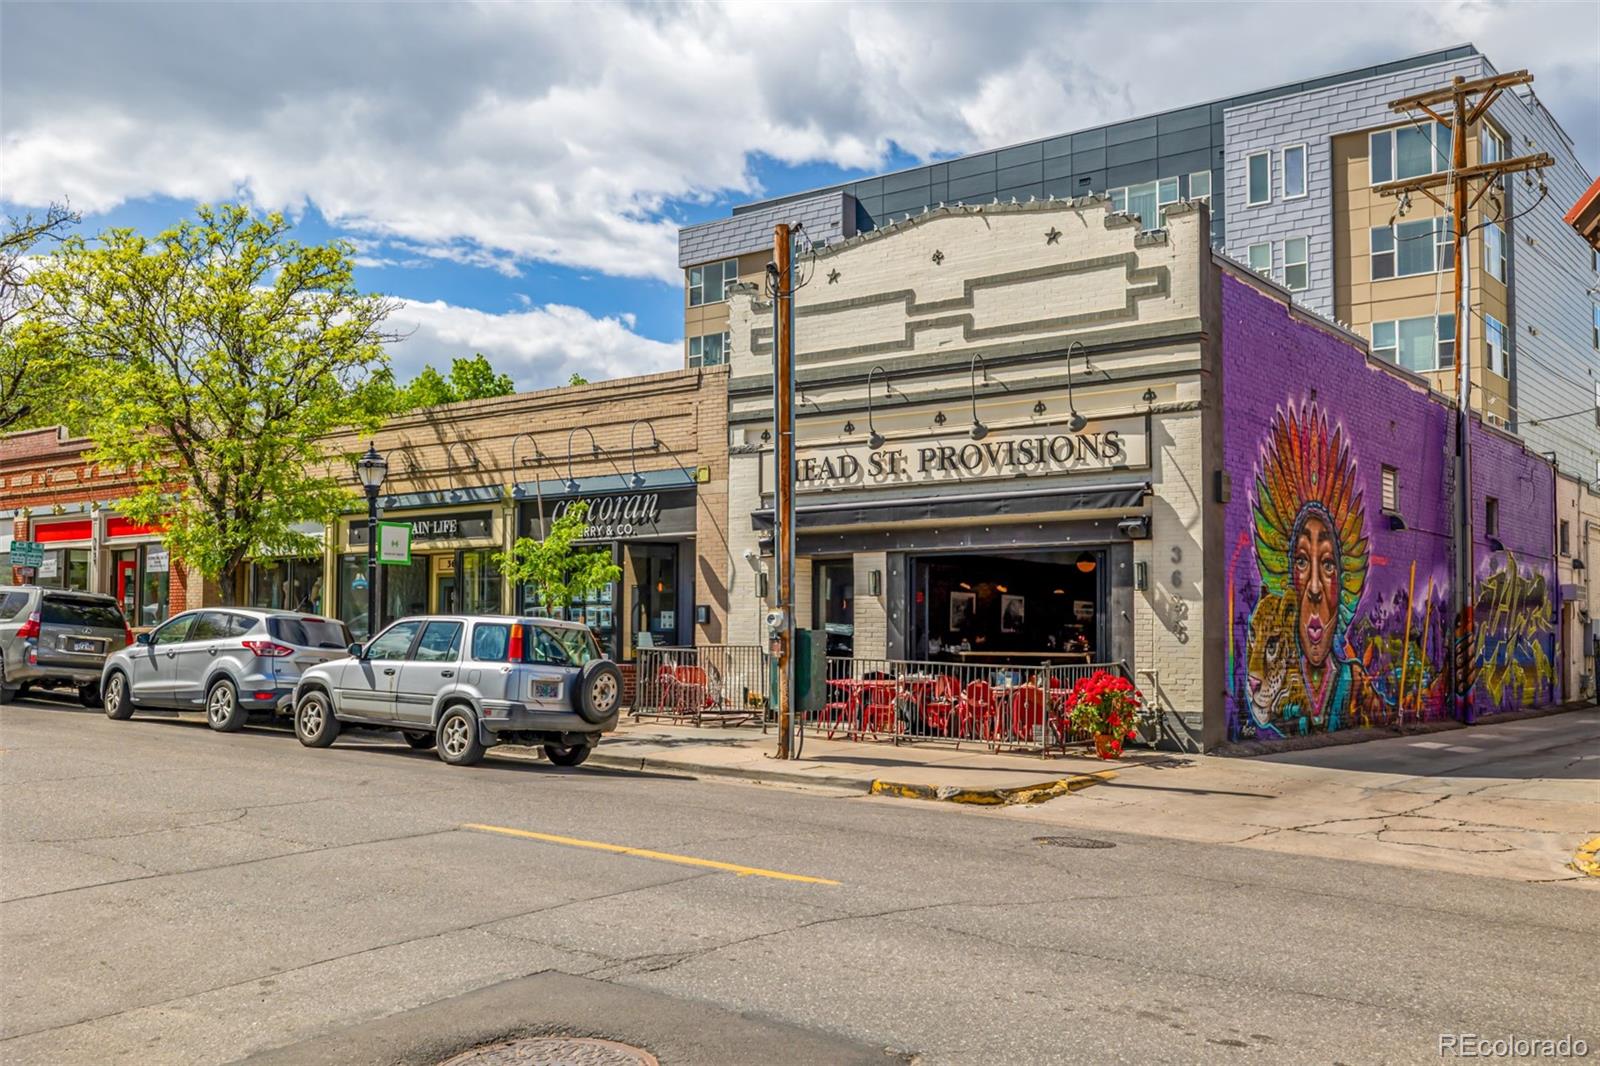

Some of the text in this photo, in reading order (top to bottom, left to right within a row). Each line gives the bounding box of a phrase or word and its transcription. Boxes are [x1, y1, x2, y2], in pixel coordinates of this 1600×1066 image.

[795, 430, 1120, 482] EAD ST. PROVISIONS
[552, 493, 658, 524] corcoran
[411, 519, 457, 535] AIN LIFE
[578, 525, 602, 538] RRY
[605, 524, 614, 536] &
